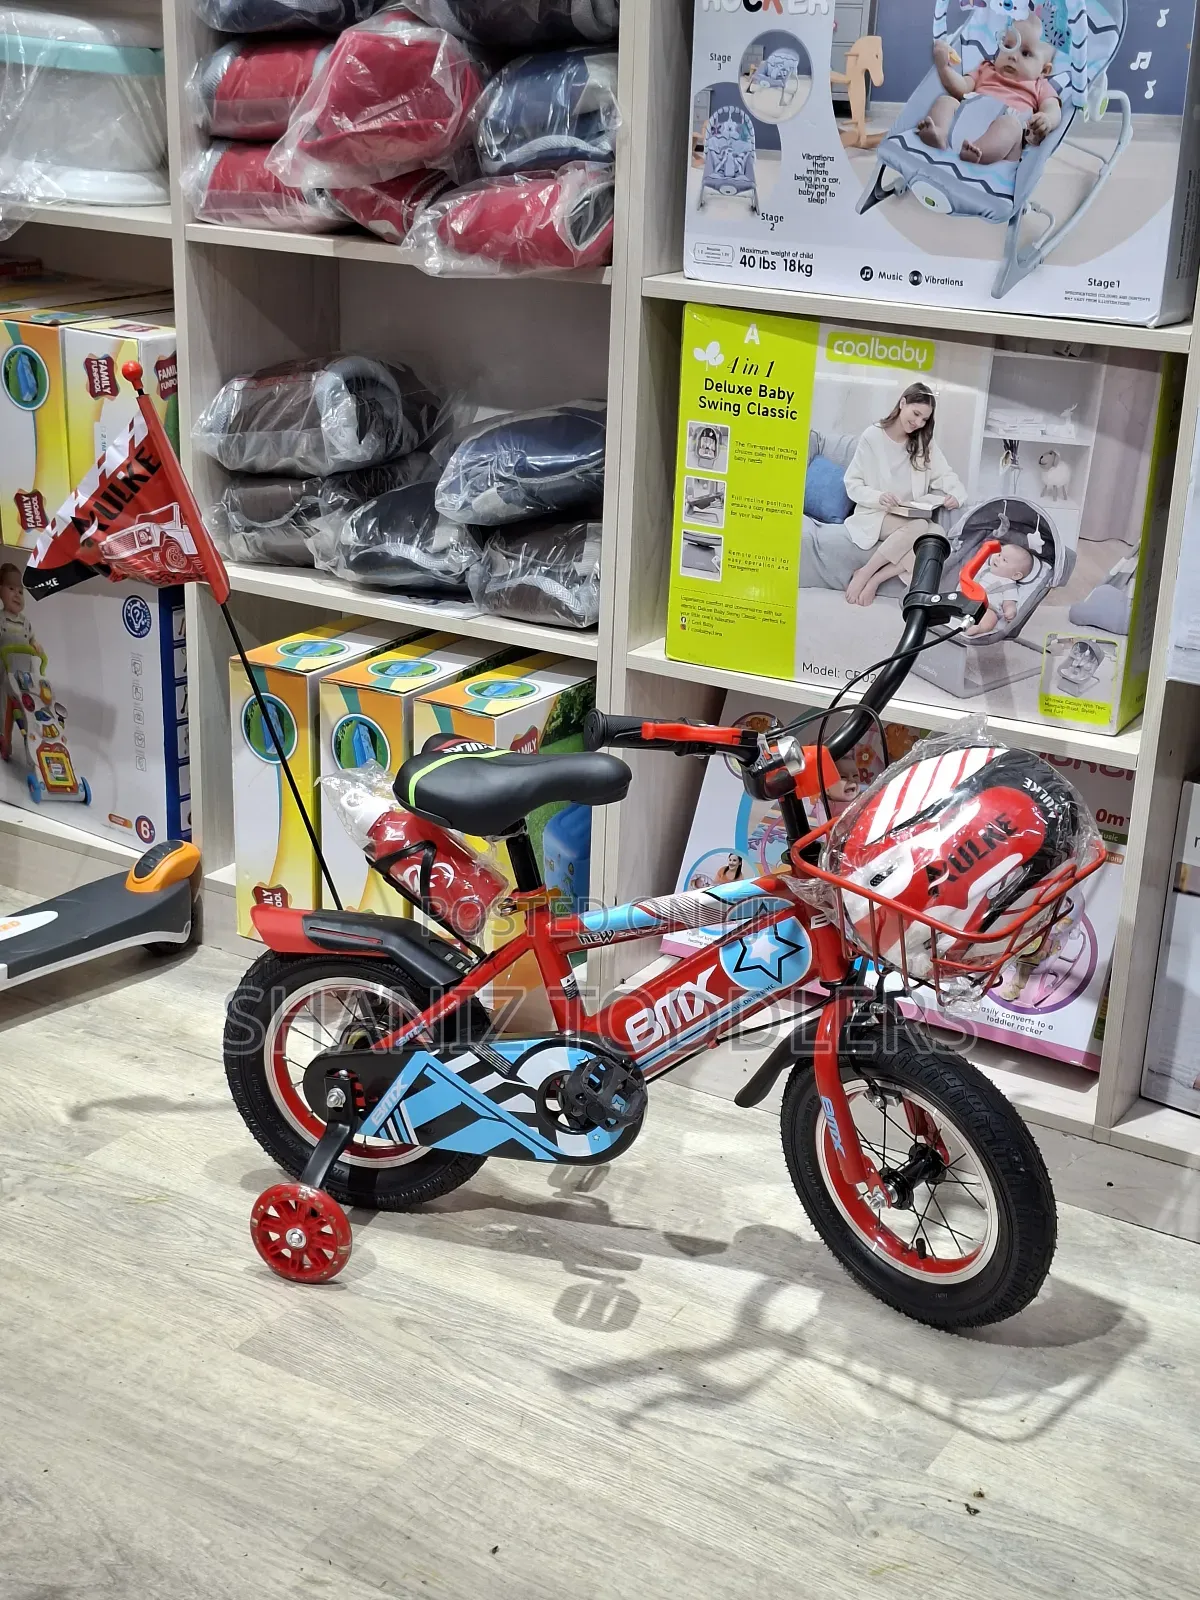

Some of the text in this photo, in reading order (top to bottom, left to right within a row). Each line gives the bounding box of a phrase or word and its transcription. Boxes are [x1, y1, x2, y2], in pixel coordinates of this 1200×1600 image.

[709, 53, 732, 62] Stage
[761, 212, 784, 223] Stage
[770, 223, 775, 231] 2
[739, 246, 769, 255] Maximum
[771, 250, 791, 259] weight
[792, 250, 798, 258] of
[739, 255, 756, 268] 40
[759, 256, 776, 270] lbs
[784, 258, 813, 277] 18kg
[878, 271, 964, 286] Music Vibrations
[744, 323, 760, 345] A
[833, 336, 928, 369] coolbaby
[90, 360, 102, 394] FUNPOOL
[98, 359, 112, 394] FAMILY
[158, 364, 177, 381] FAMIL
[727, 356, 775, 378] 4 in 1
[160, 378, 177, 392] FUNPO
[704, 378, 795, 405] Deluxe Baby
[698, 395, 798, 421] Swing Classic
[22, 495, 36, 528] FAMILY
[31, 496, 42, 527] FUNPOOL
[802, 661, 840, 679] Model:
[624, 964, 725, 1053] BMX
[981, 1006, 999, 1018] asily
[1001, 1012, 1035, 1026] converts
[1037, 1020, 1046, 1029] to
[986, 1015, 1043, 1036] toddler rocker
